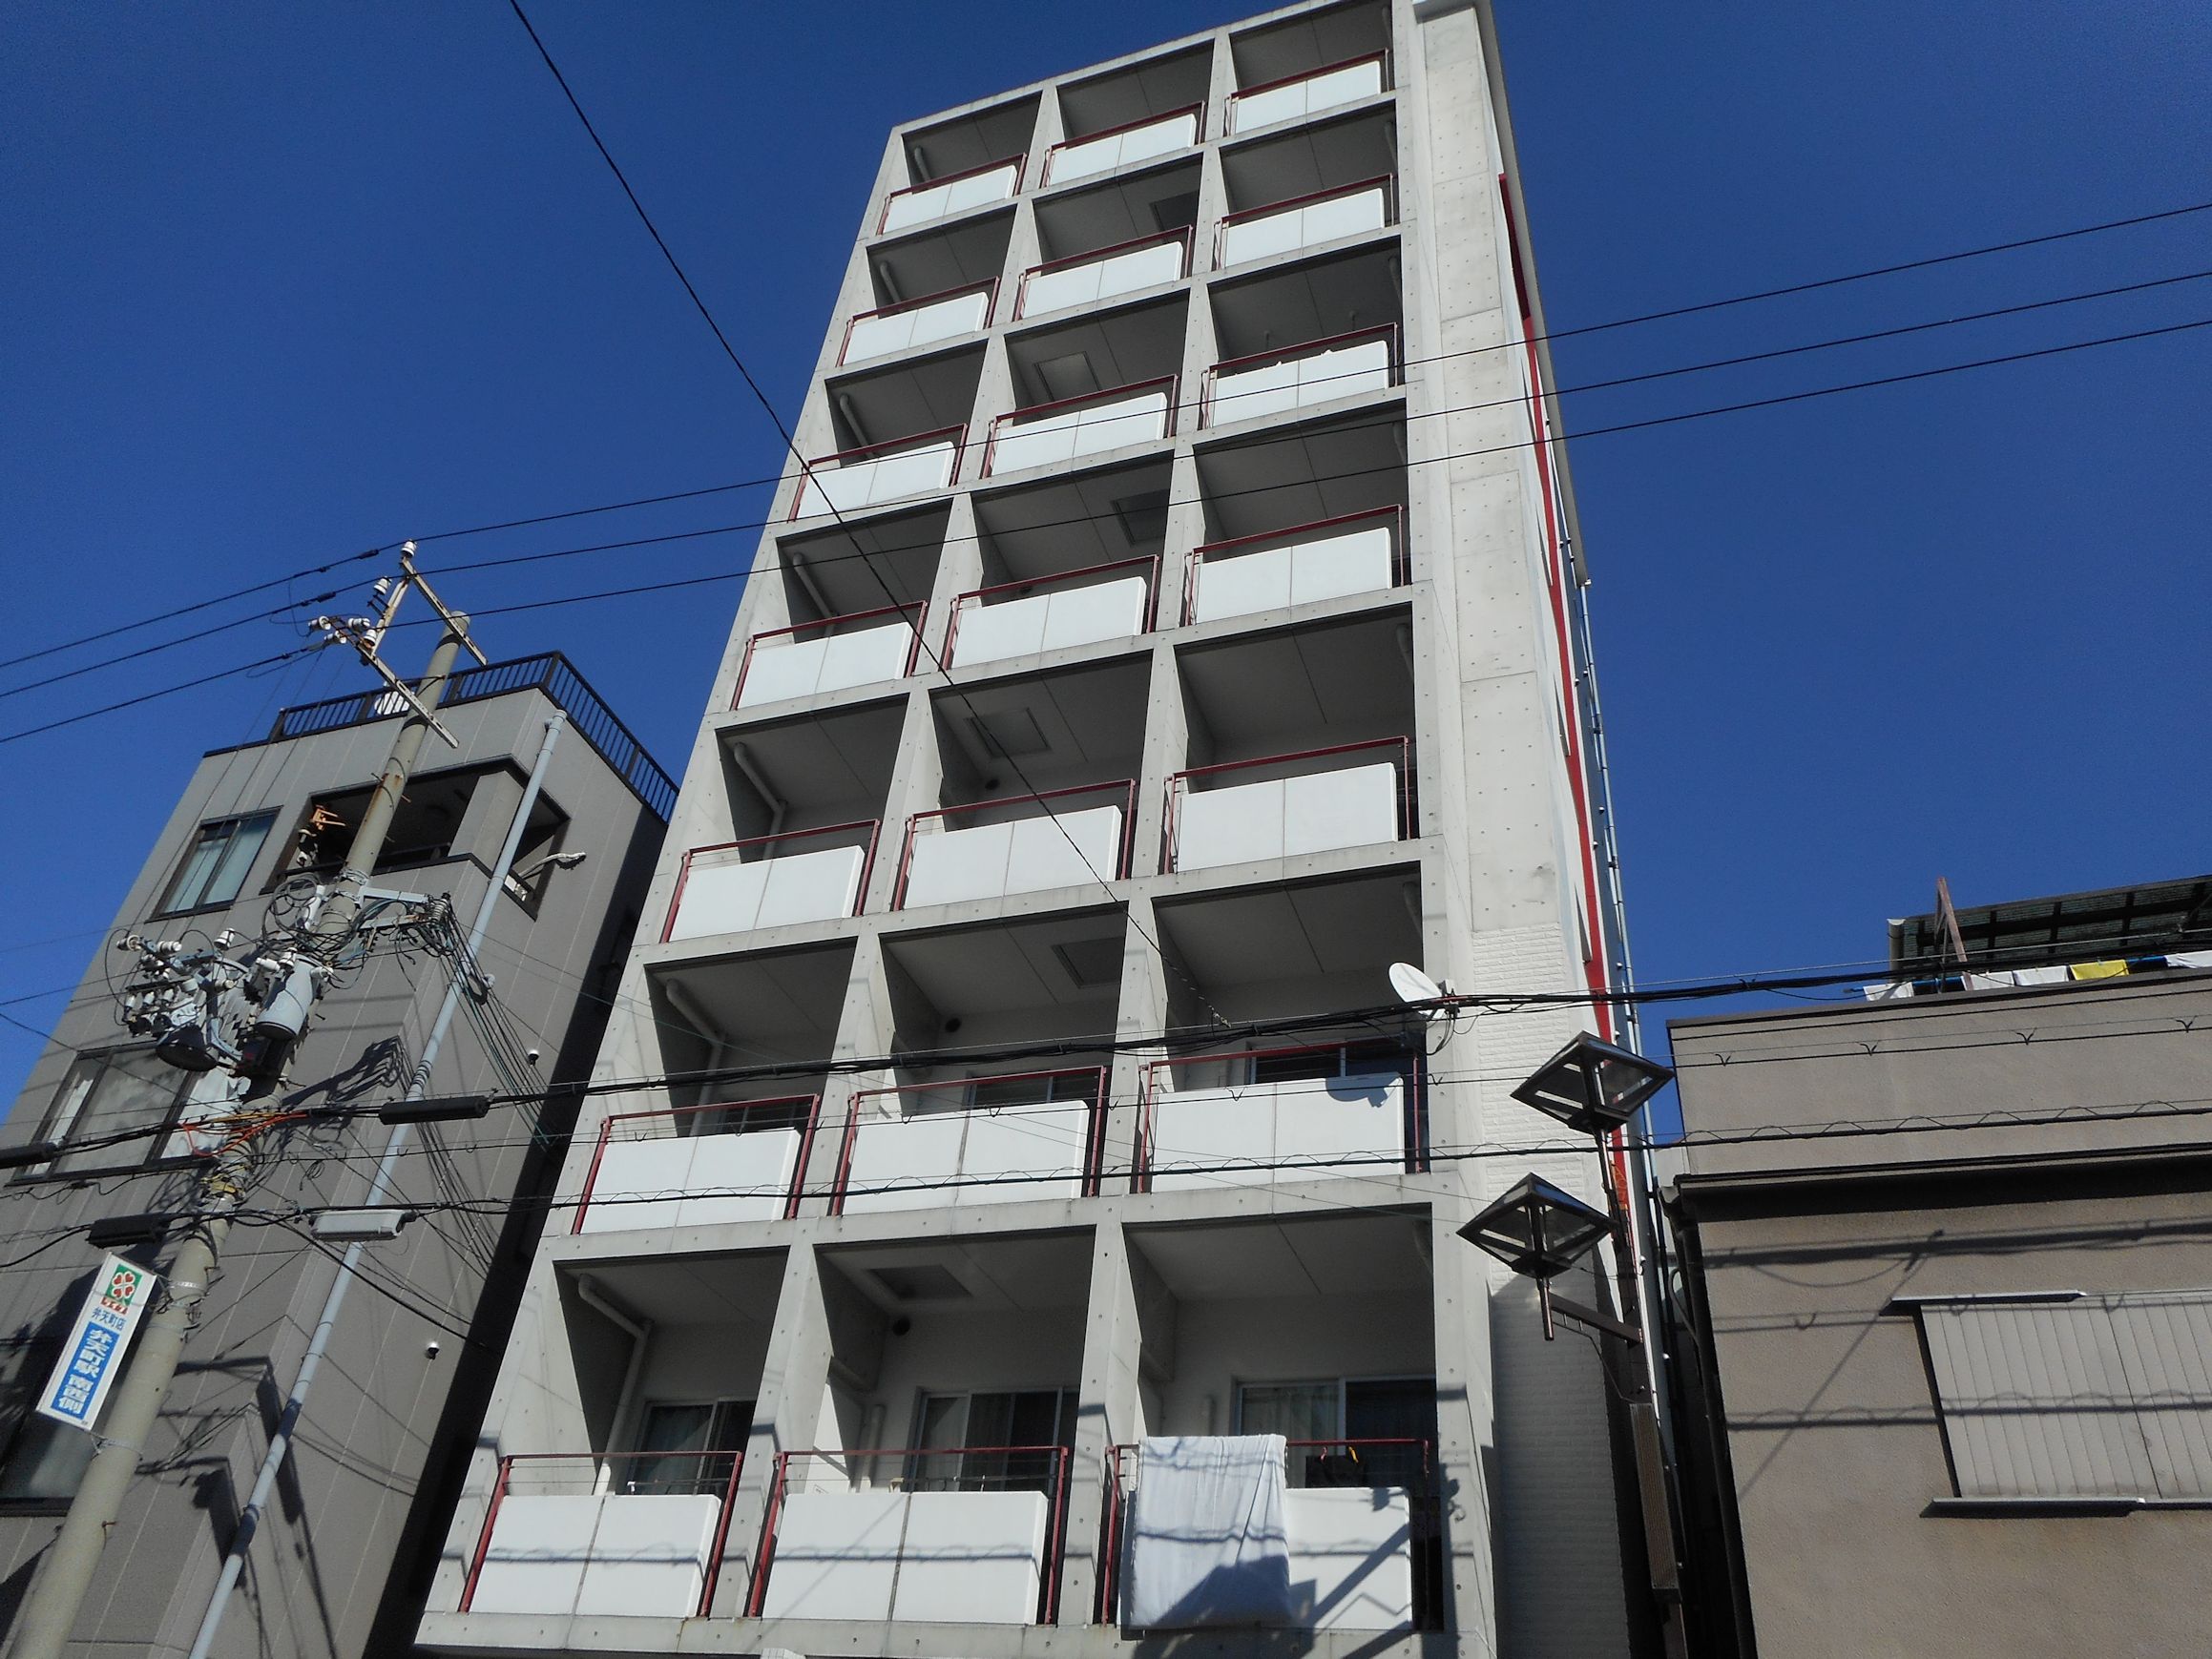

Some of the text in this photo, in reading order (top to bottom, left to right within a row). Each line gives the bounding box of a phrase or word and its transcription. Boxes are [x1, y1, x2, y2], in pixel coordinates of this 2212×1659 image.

[92, 1307, 126, 1331] 弁天町店
[58, 1330, 113, 1414] 弁天町駅 南西側
